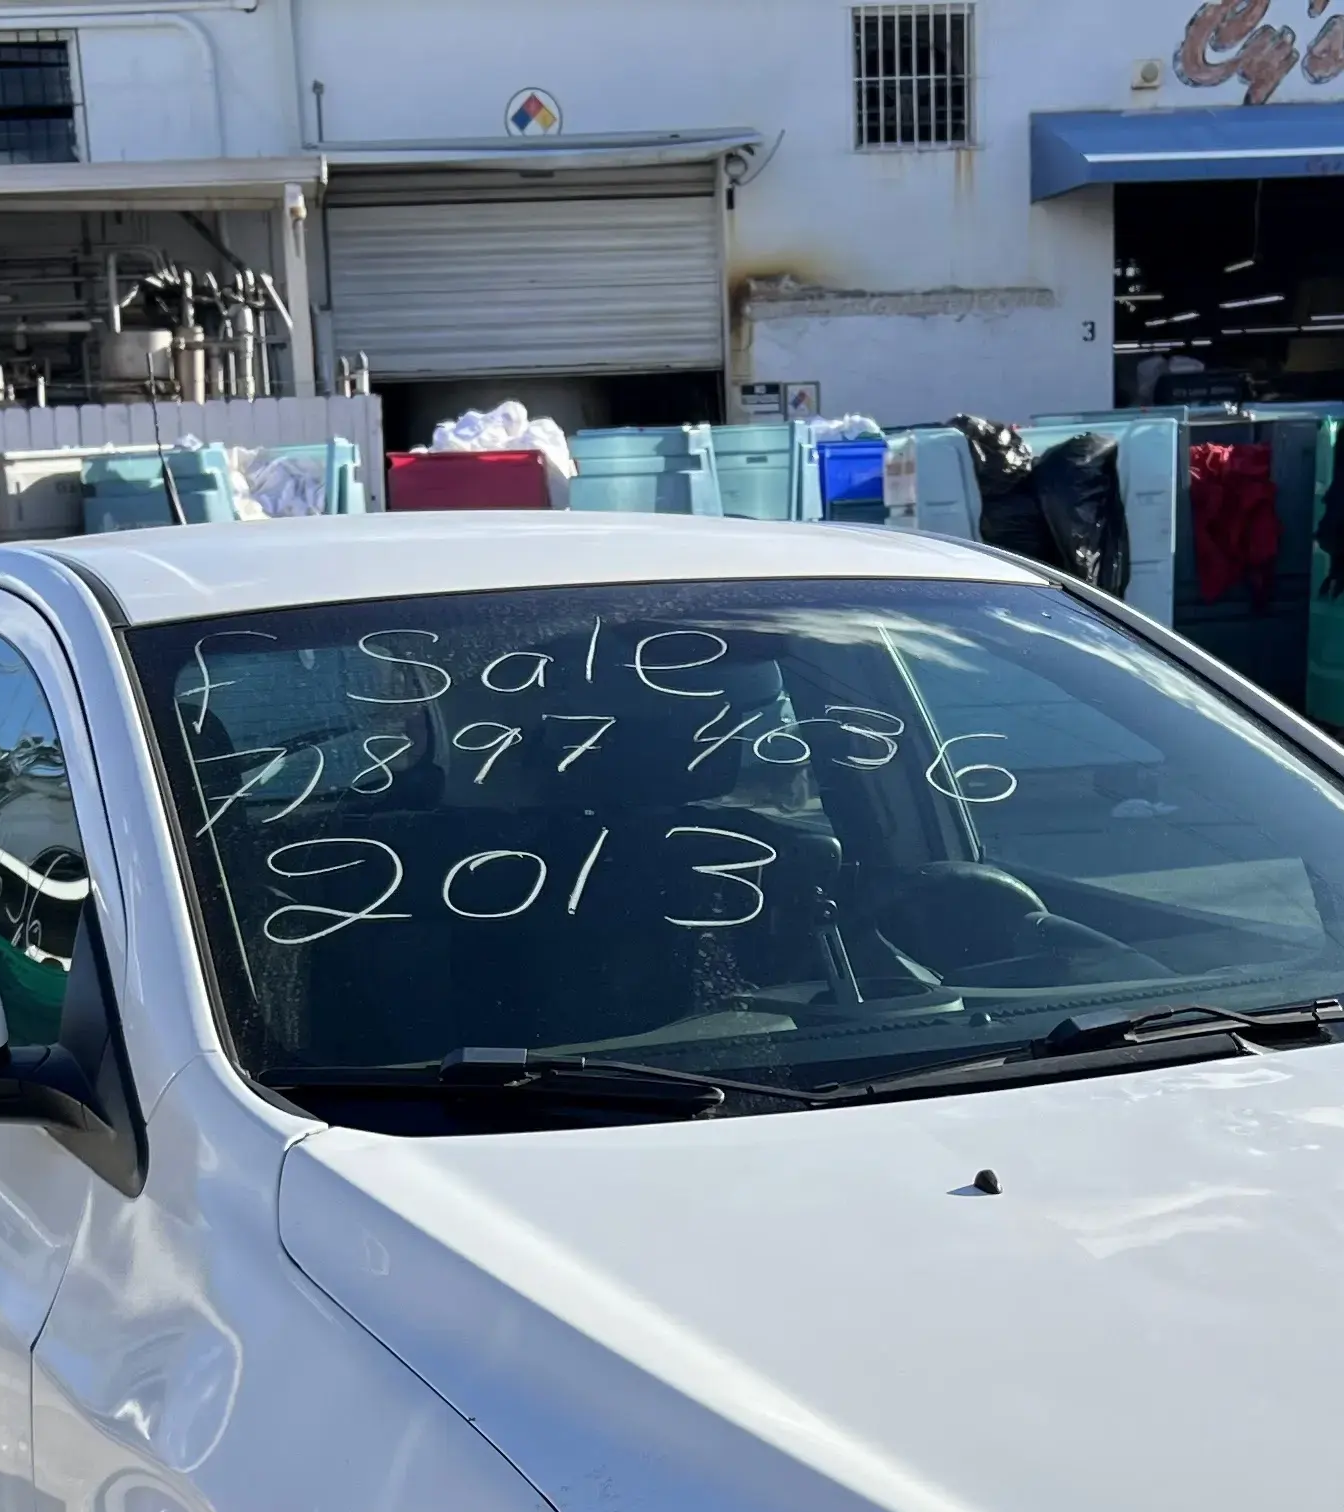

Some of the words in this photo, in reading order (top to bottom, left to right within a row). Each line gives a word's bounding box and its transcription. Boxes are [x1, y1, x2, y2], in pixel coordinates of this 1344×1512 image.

[1081, 320, 1097, 342] 3
[346, 615, 729, 704] Sale
[263, 825, 778, 946] 2013
